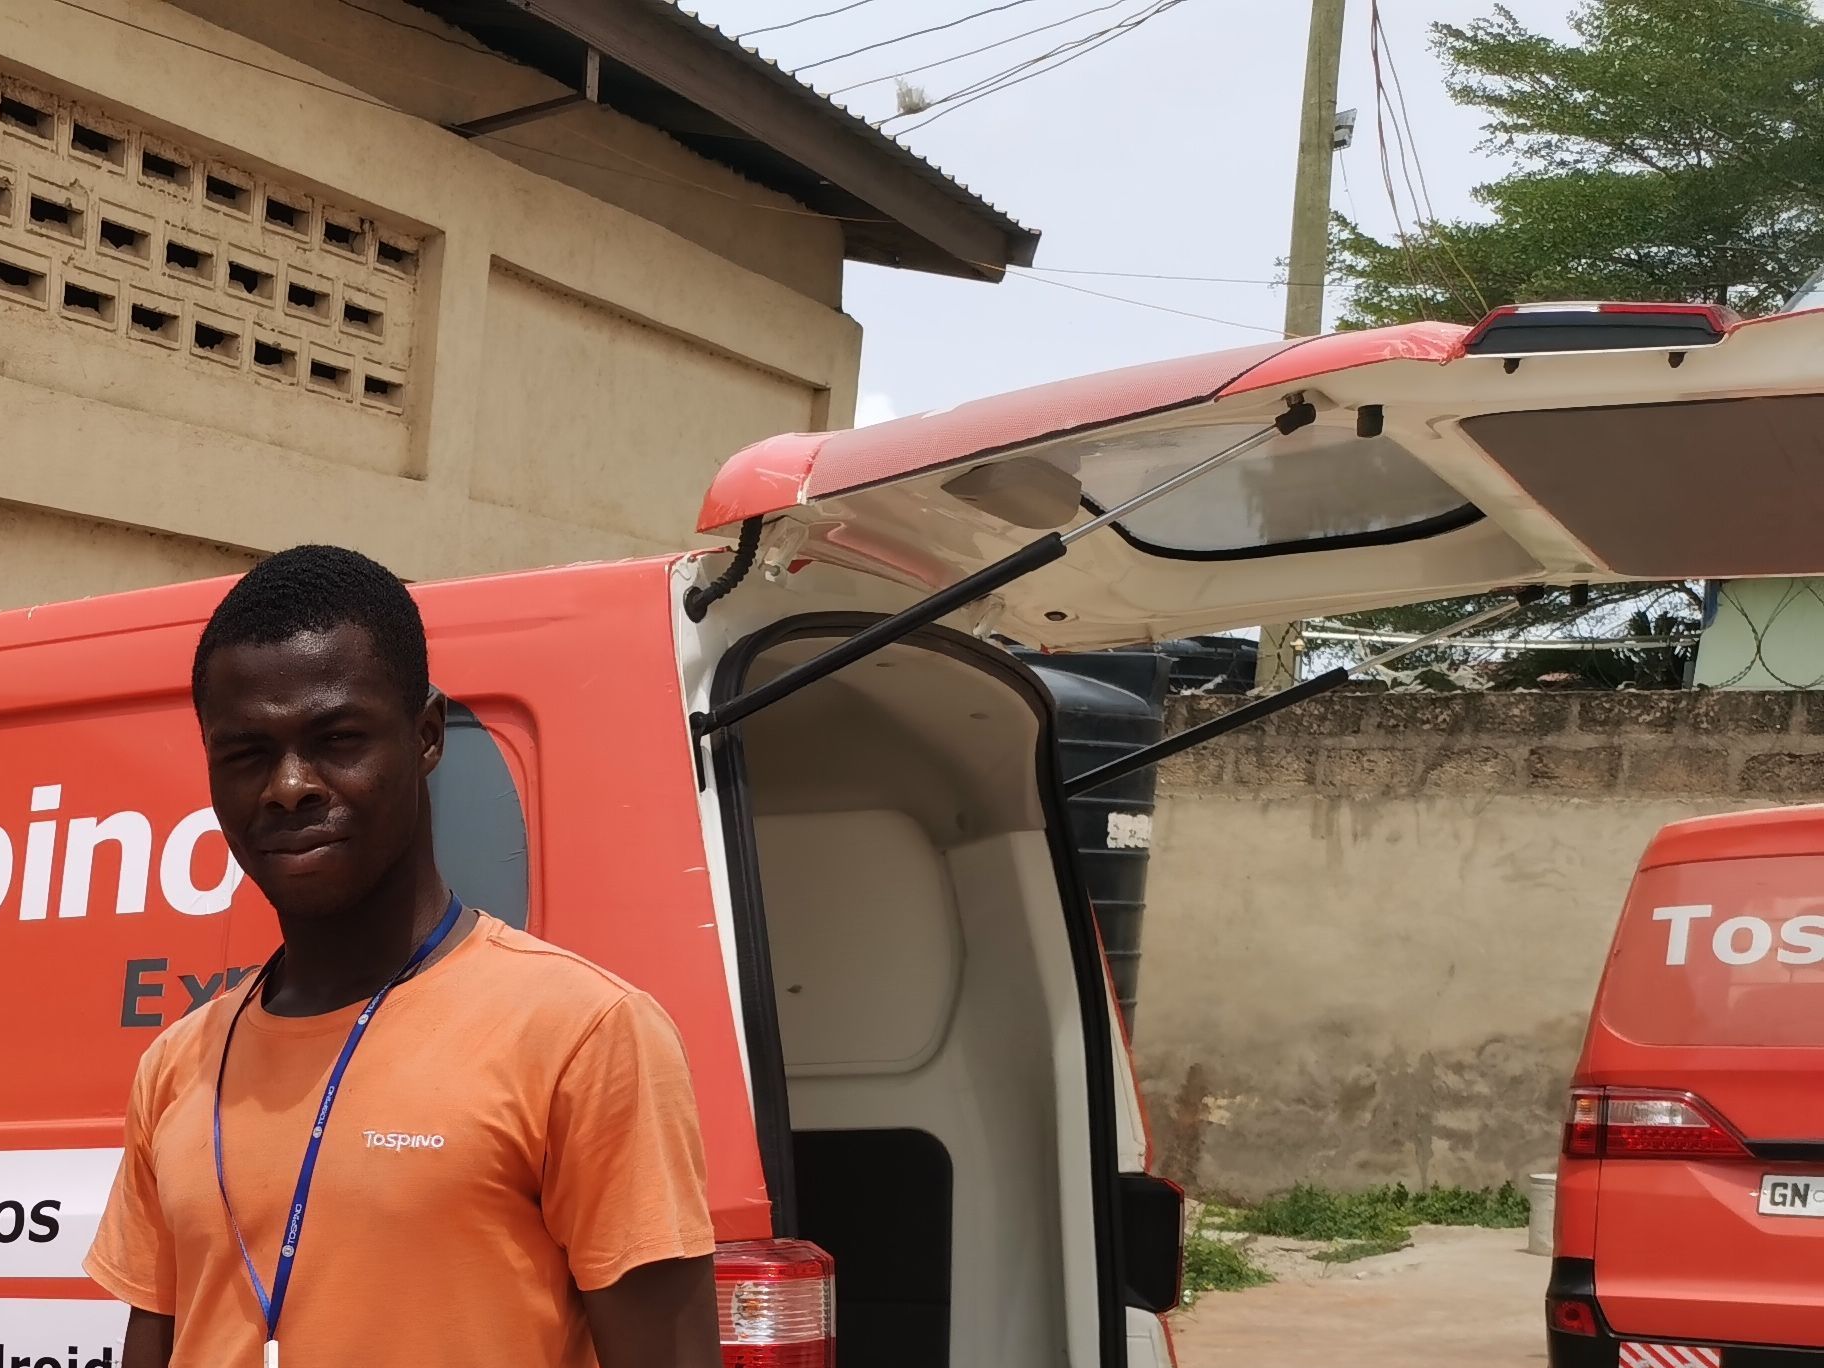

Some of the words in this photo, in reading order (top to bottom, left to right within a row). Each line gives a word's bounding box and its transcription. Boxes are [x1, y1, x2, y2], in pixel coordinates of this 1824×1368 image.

[1652, 904, 1824, 965] Tos
[1770, 1181, 1811, 1209] GN
[286, 1203, 303, 1245] TOSPINO
